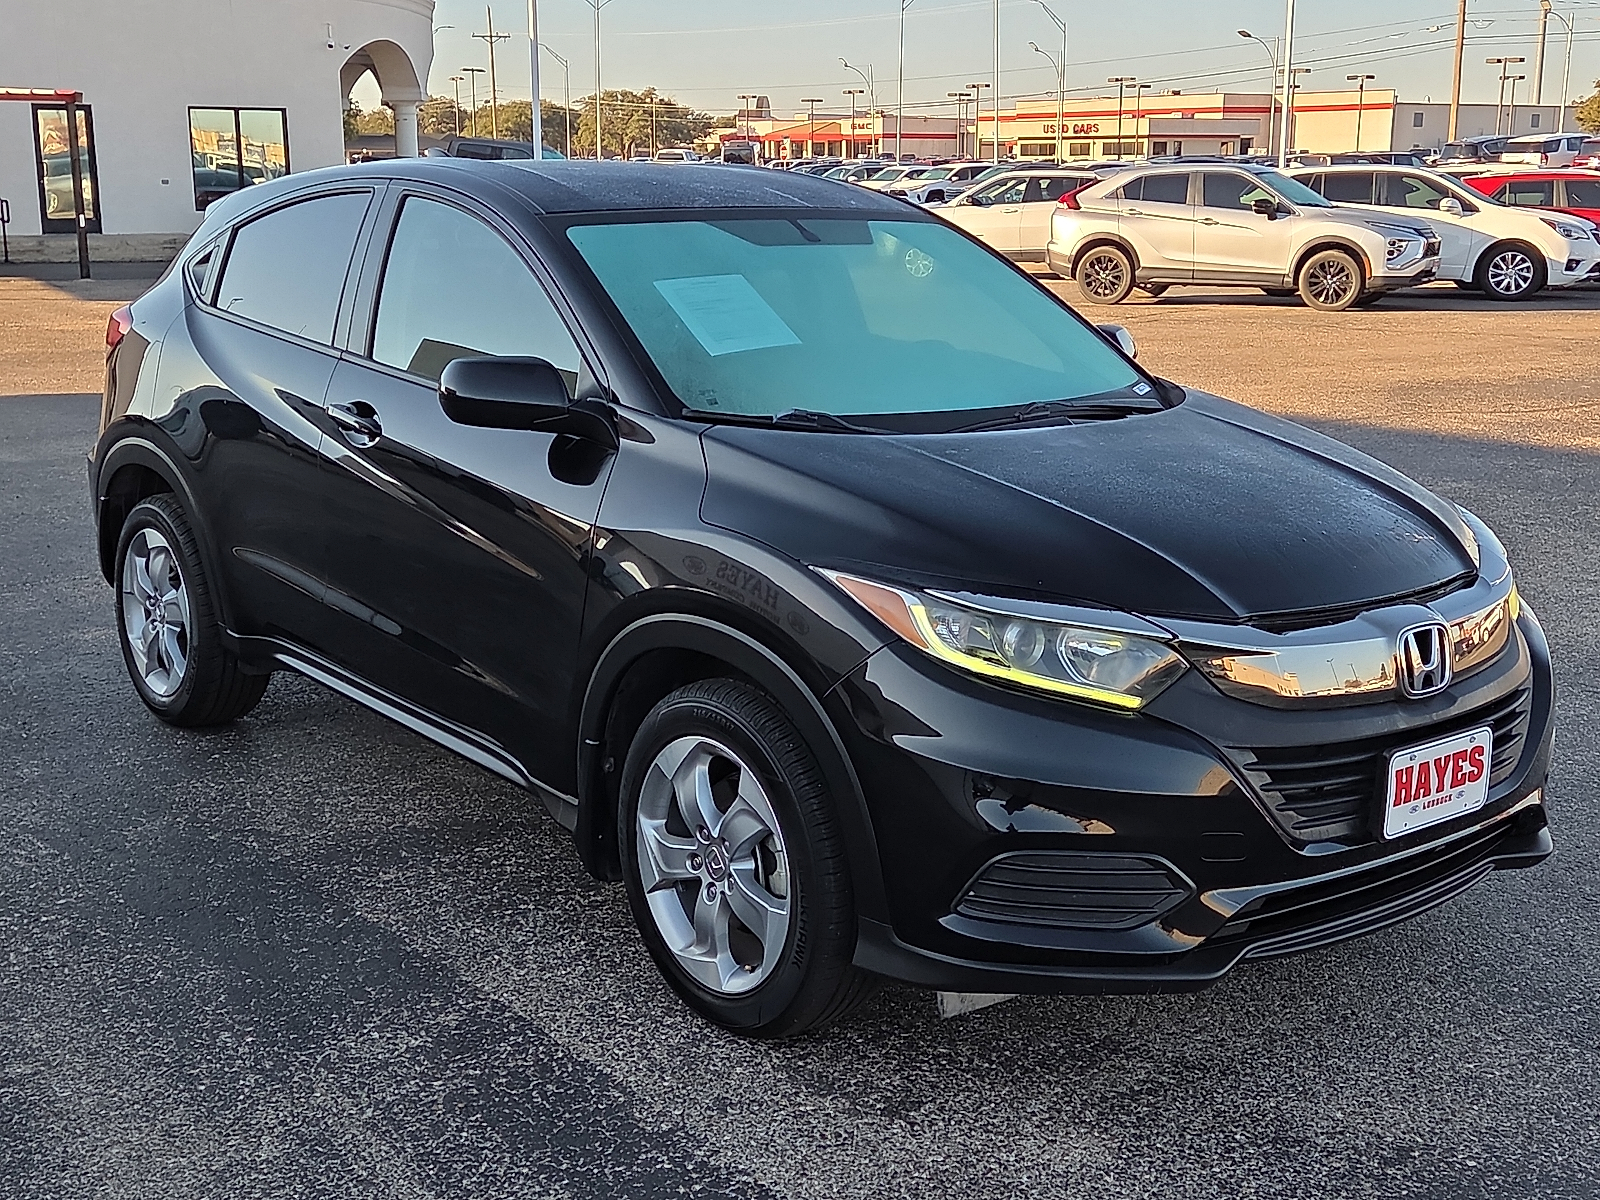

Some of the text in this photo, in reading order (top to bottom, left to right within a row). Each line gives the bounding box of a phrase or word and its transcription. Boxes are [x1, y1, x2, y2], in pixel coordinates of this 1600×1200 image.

[1043, 123, 1099, 134] USD CARS
[1393, 745, 1485, 807] HAYES
